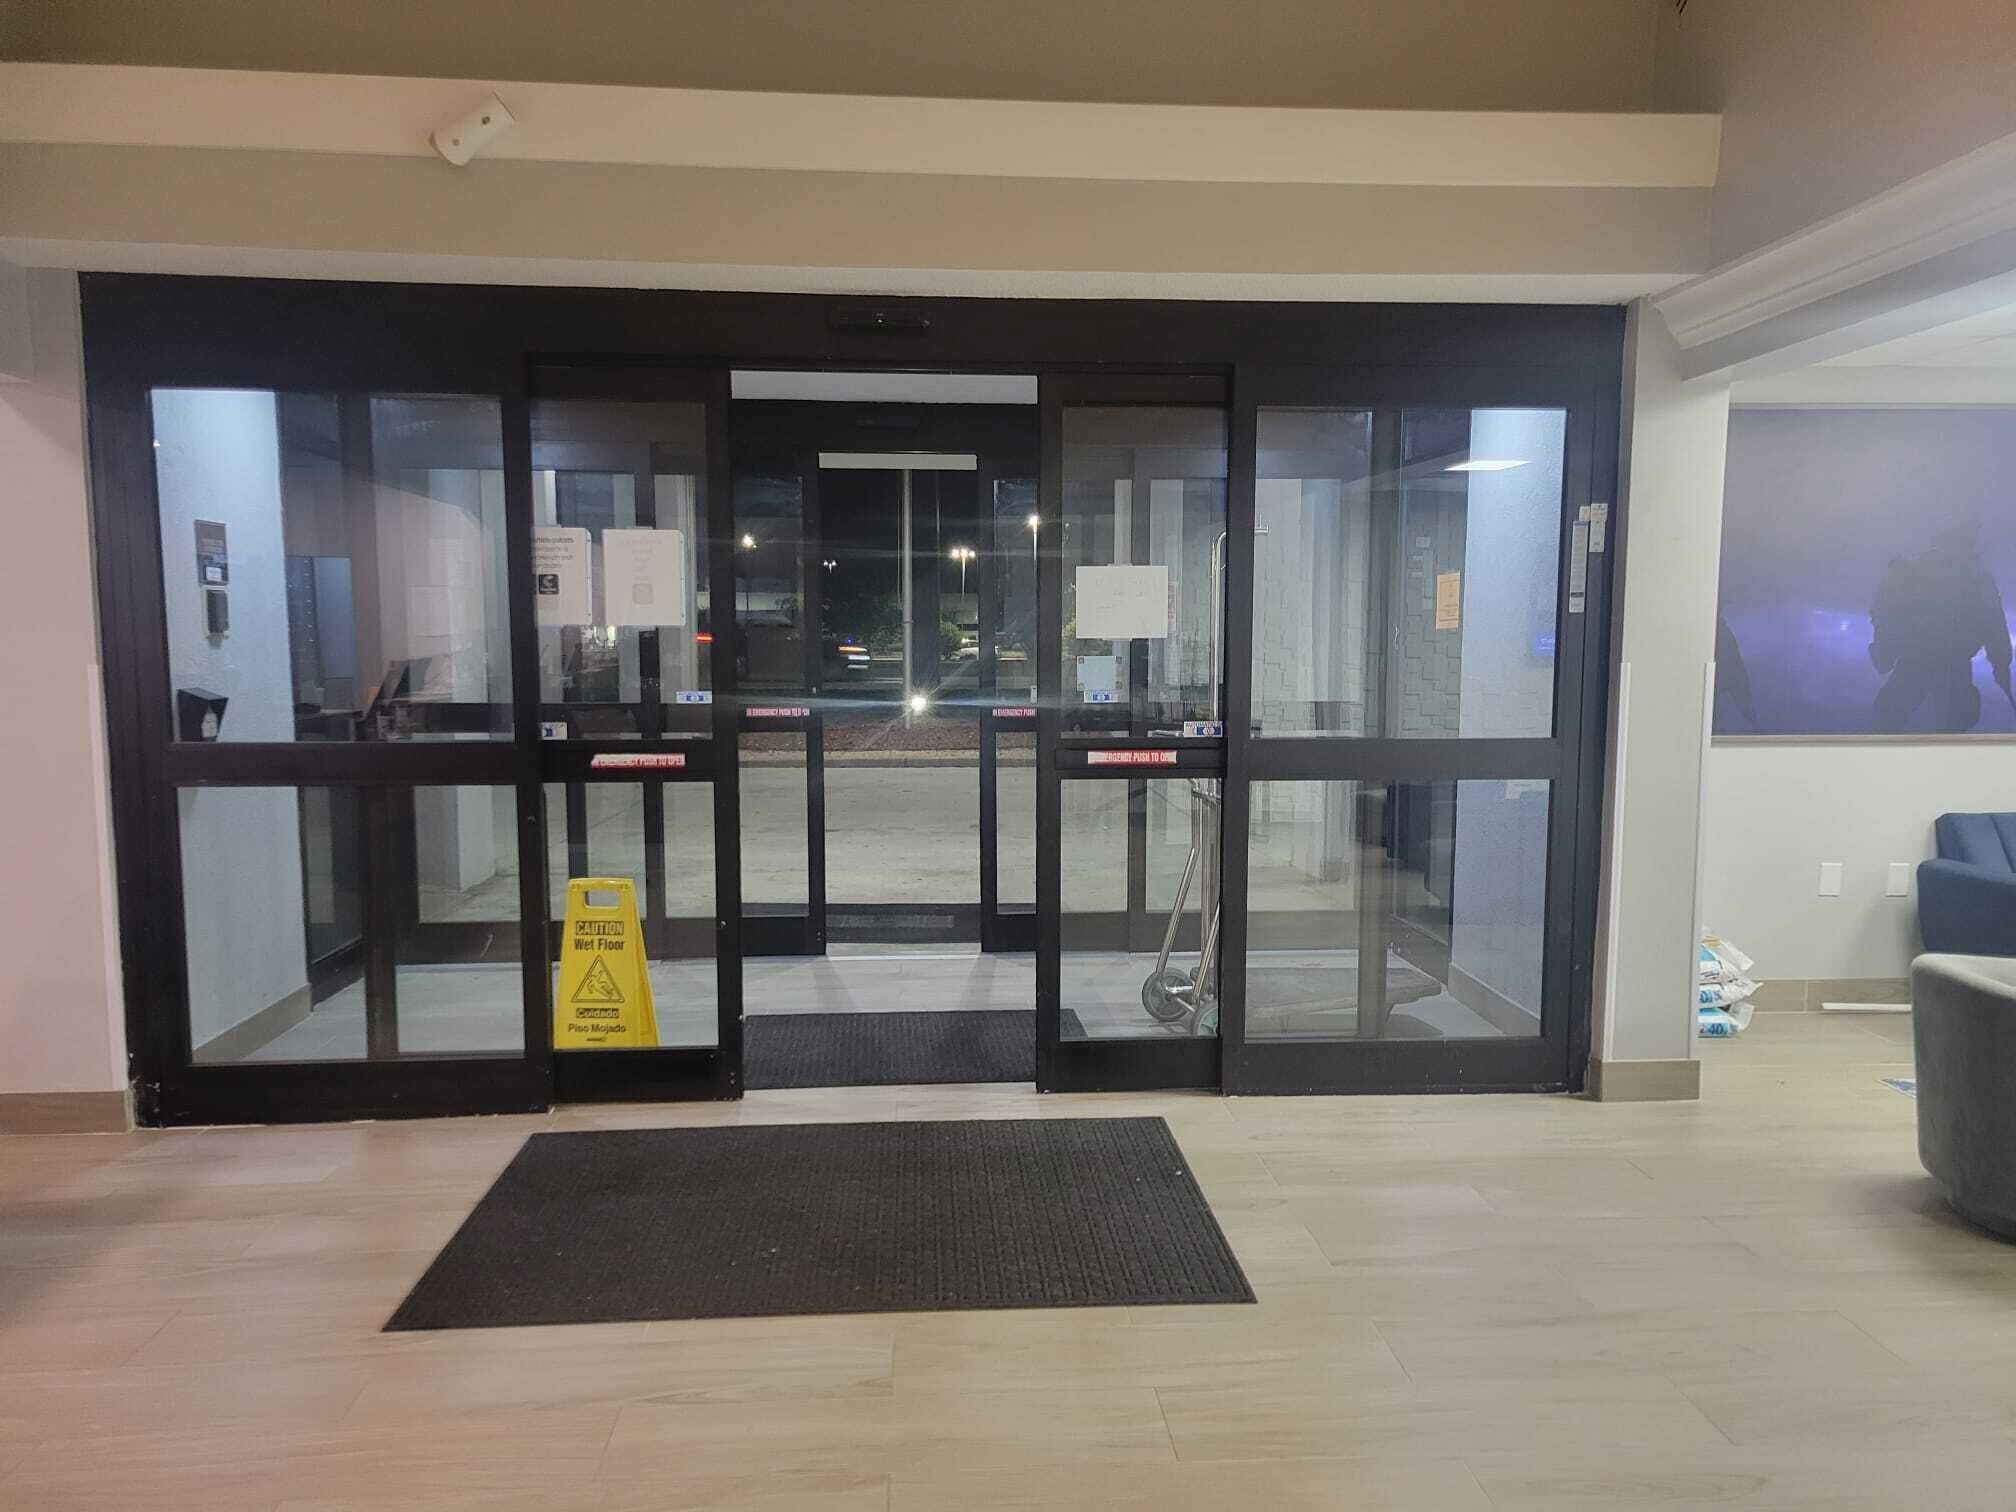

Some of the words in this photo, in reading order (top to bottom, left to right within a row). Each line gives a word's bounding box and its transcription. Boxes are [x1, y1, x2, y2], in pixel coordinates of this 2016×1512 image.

[1133, 751, 1150, 763] PUSH
[1151, 751, 1159, 762] TO
[576, 921, 624, 935] CAUTION
[575, 939, 594, 950] Wet
[598, 938, 625, 950] Floor
[577, 1008, 619, 1018] Cuidado
[568, 1023, 589, 1033] Piso
[591, 1023, 626, 1034] Mojado
